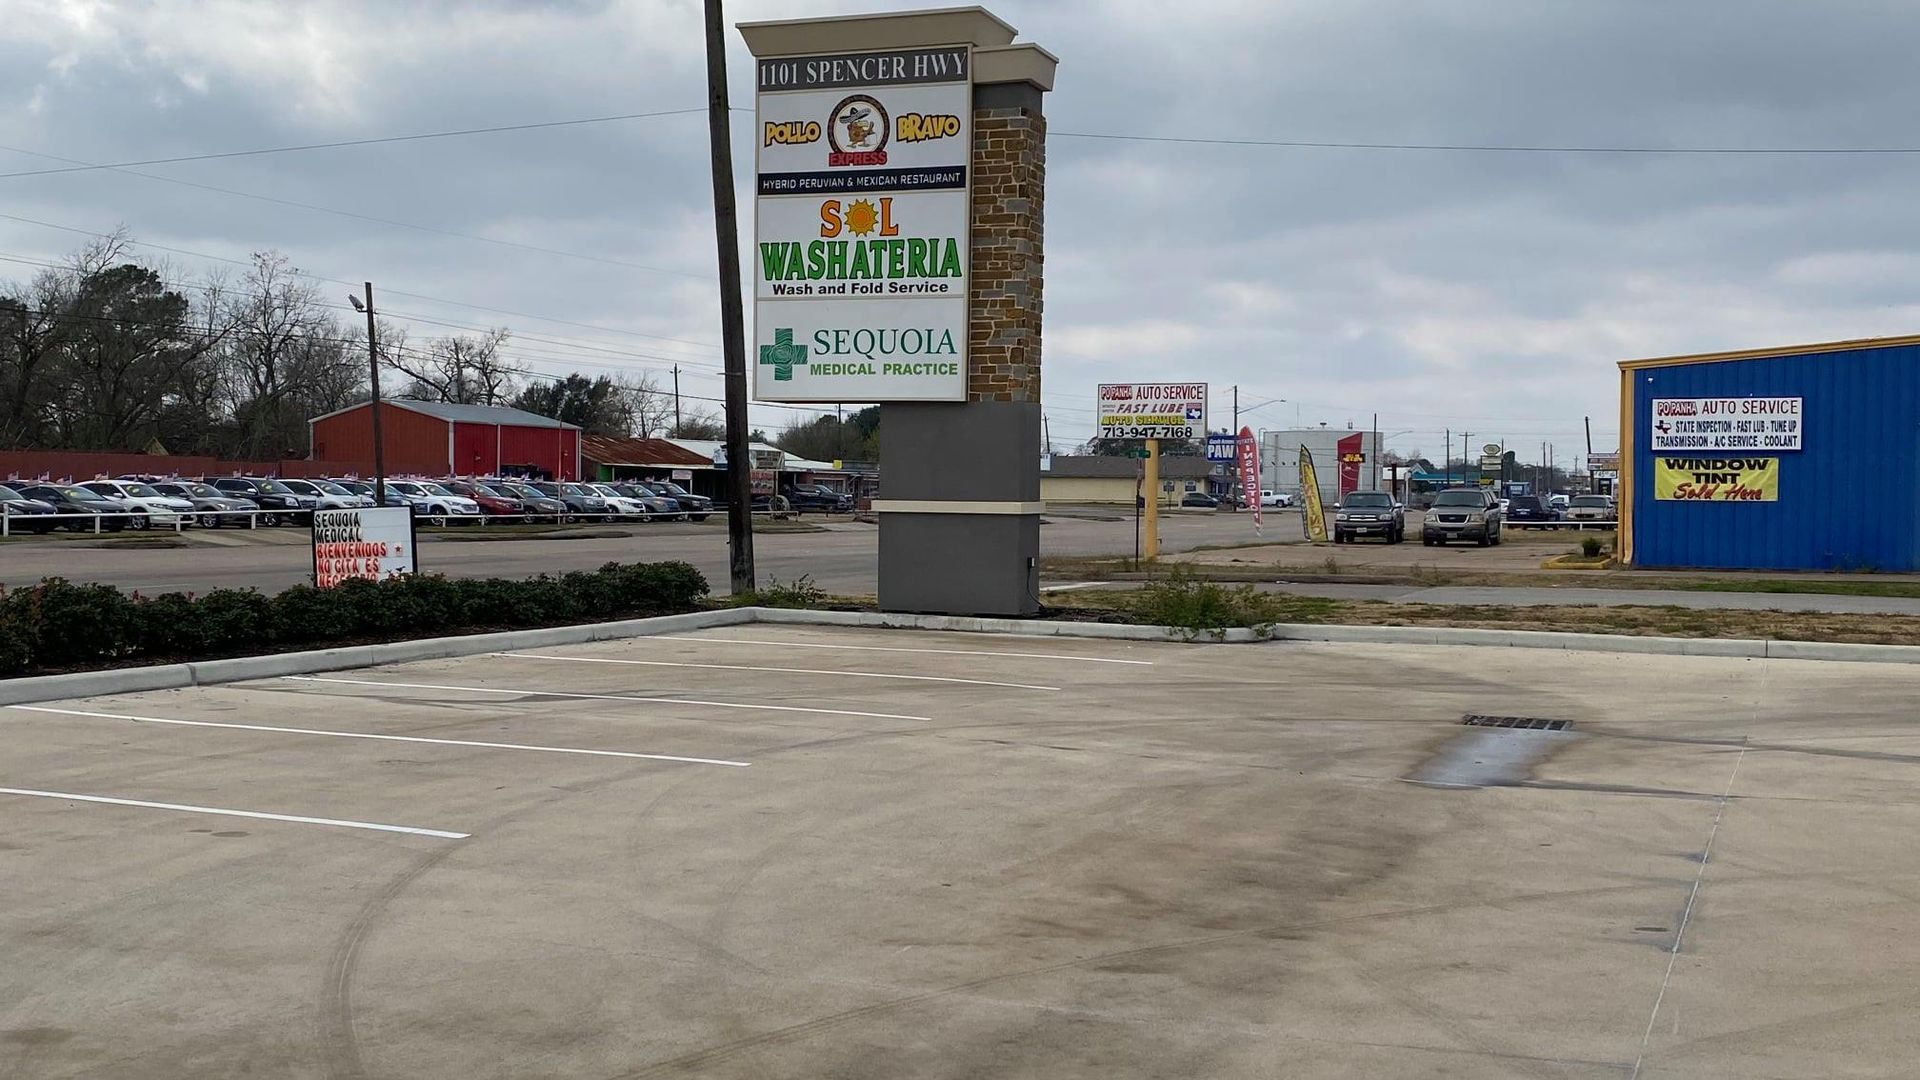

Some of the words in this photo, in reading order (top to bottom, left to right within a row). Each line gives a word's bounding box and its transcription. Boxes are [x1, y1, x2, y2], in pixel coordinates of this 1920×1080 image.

[761, 63, 798, 86] 1101
[806, 56, 905, 84] SPENCER
[914, 52, 967, 76] HWY
[764, 121, 821, 147] POLLO
[896, 113, 960, 143] BRAVO
[829, 151, 887, 167] EXPRESS
[763, 179, 797, 190] HYBRID
[799, 177, 845, 188] PERUVIAN
[847, 177, 854, 187] &
[856, 175, 898, 186] MEXICAN
[900, 172, 961, 185] RESTAURANT
[760, 237, 962, 281] WASHATERIA
[772, 284, 813, 295] Wash
[818, 283, 846, 295] and
[851, 282, 884, 294] Fold
[888, 281, 949, 293] Service
[813, 328, 958, 360] SEQUOIA
[810, 363, 877, 376] MEDICAL
[883, 363, 958, 375] PRACTICE
[1136, 386, 1161, 400] AUTO
[1163, 385, 1203, 400] SERVICE
[1116, 403, 1149, 413] FAST
[1151, 403, 1185, 413] LUBE
[1702, 400, 1736, 414] AUTO
[1742, 400, 1798, 414] SERVICE
[1101, 415, 1133, 425] AUTO
[1136, 415, 1185, 425] SERVICE
[1675, 420, 1695, 433] STATE
[1696, 420, 1732, 433] INSPECTION
[1736, 420, 1752, 433] FAST
[1771, 420, 1787, 433] TUNE
[1788, 420, 1797, 432] UP
[1103, 427, 1192, 438] 713-947-7168
[1656, 436, 1709, 447] TRANSMISSION
[1728, 436, 1758, 447] SERVICE
[1764, 436, 1798, 447] COOLANT
[1664, 459, 1769, 470] WINDOW
[1692, 473, 1740, 484] TINT
[1673, 482, 1720, 499] Sold
[1724, 483, 1763, 500] Here
[315, 512, 360, 528] SEQUOIA
[316, 528, 362, 543] MEDICAL
[317, 542, 387, 558] BIENVENIDOS
[318, 559, 331, 574] NO
[335, 559, 360, 574] CITA
[365, 558, 379, 573] ES
